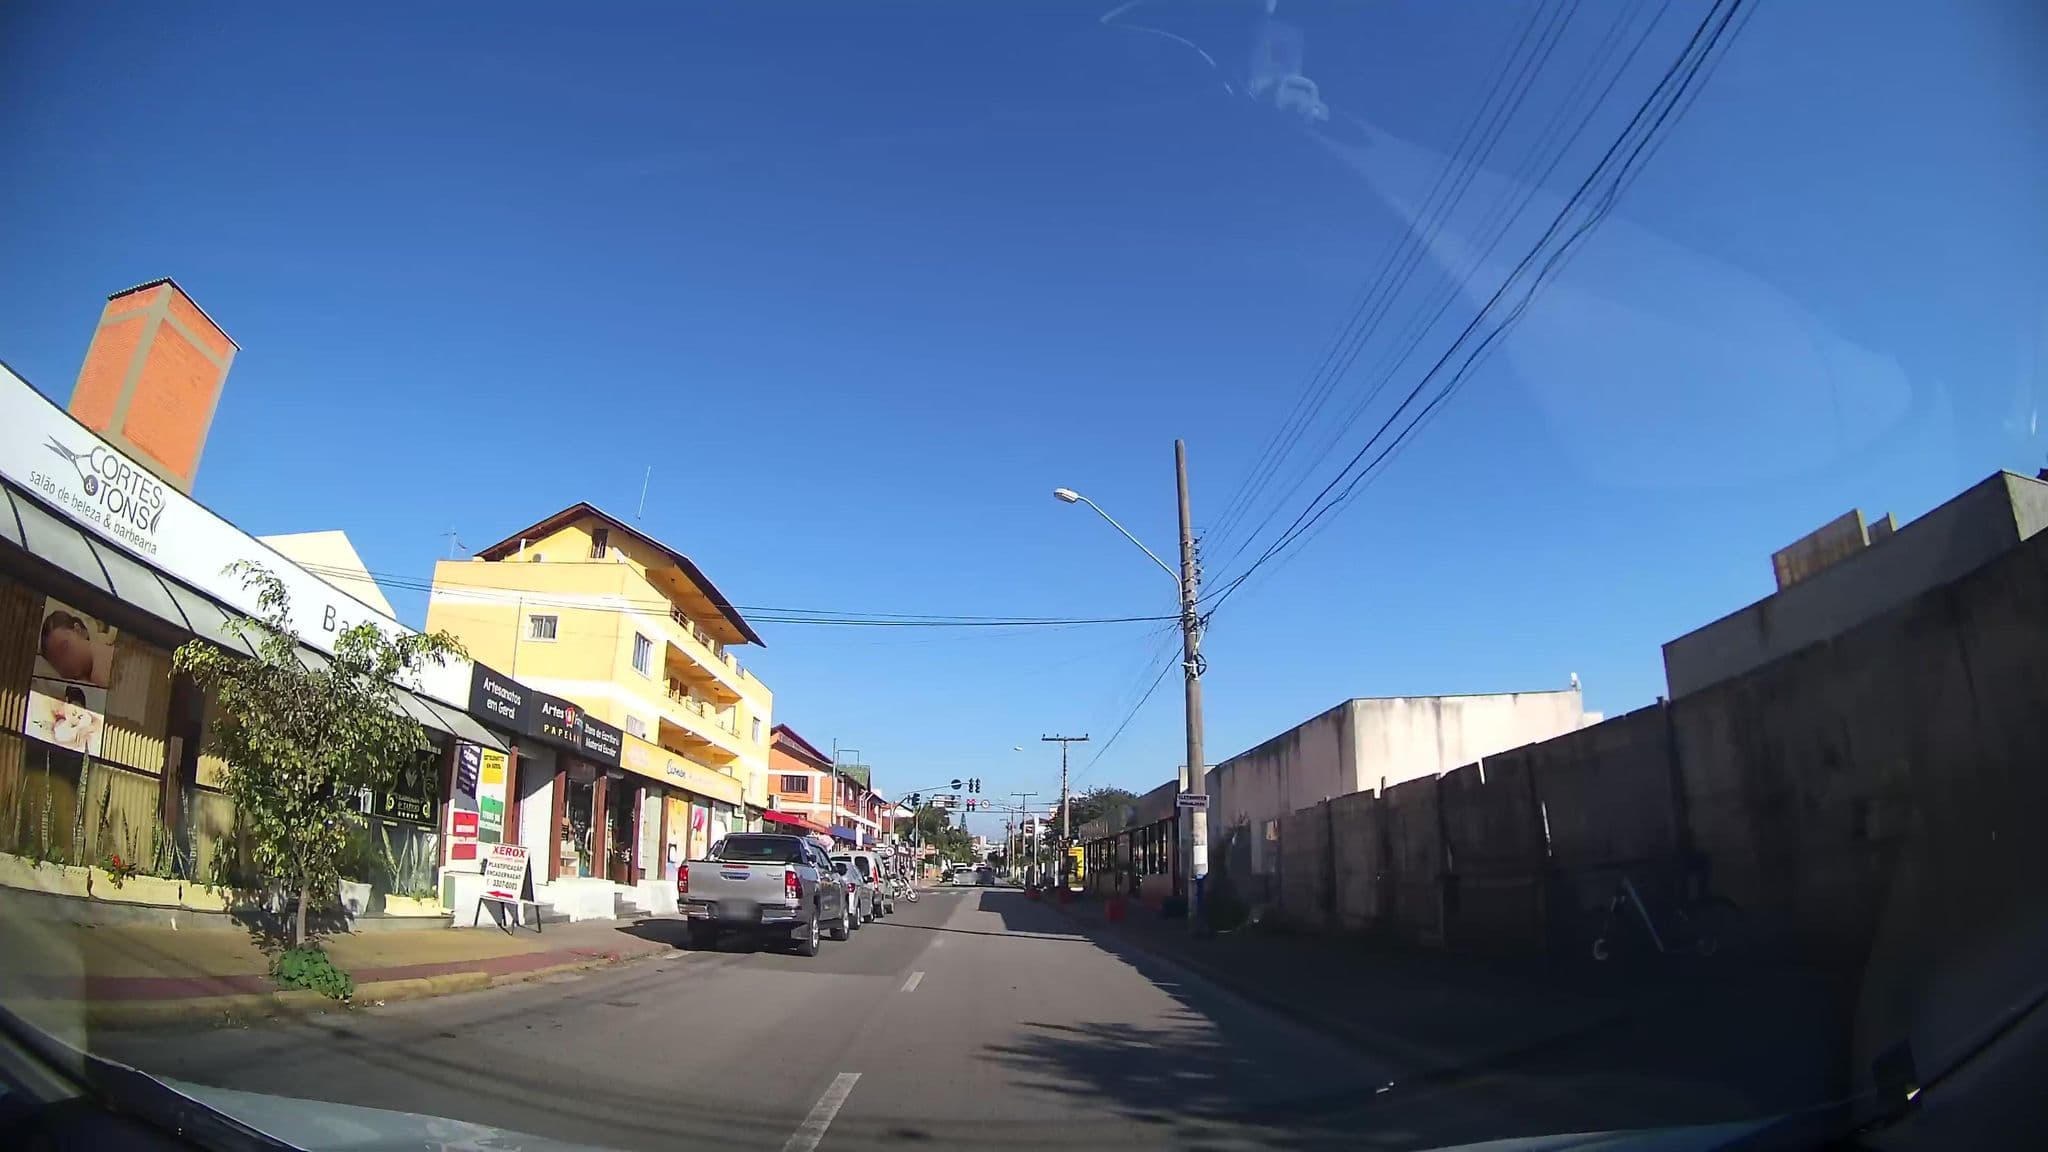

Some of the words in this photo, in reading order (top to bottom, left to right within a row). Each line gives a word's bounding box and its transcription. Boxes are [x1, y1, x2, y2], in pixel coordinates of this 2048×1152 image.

[90, 445, 163, 510] CORTES
[29, 469, 56, 495] salão
[57, 486, 70, 504] de
[71, 496, 102, 523] beleza
[103, 514, 111, 530] &
[114, 520, 157, 555] barbearia
[99, 480, 151, 531] TONS
[483, 677, 521, 706] Artesanatos
[486, 698, 498, 712] em
[498, 701, 515, 720] Geral
[541, 702, 564, 720] Artes
[493, 845, 526, 859] XEROX
